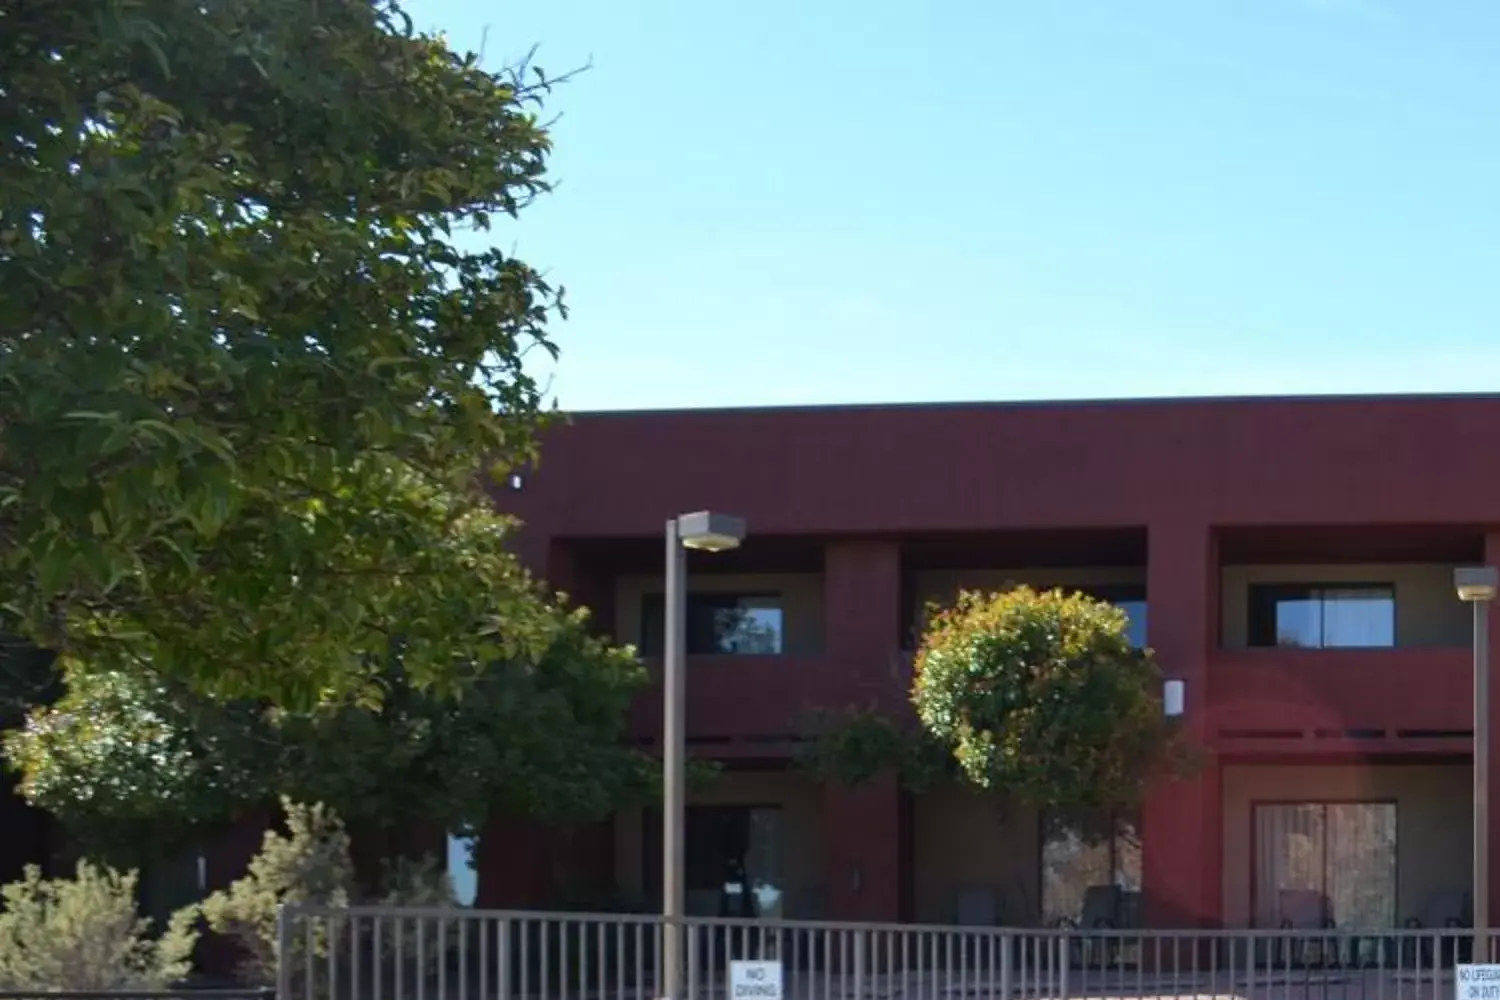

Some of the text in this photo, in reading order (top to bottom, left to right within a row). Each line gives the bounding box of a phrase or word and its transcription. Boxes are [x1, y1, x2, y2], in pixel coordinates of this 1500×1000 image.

[745, 967, 766, 981] NO
[1459, 969, 1470, 981] NO
[736, 984, 777, 997] DIVING
[1481, 985, 1500, 998] DUTY
